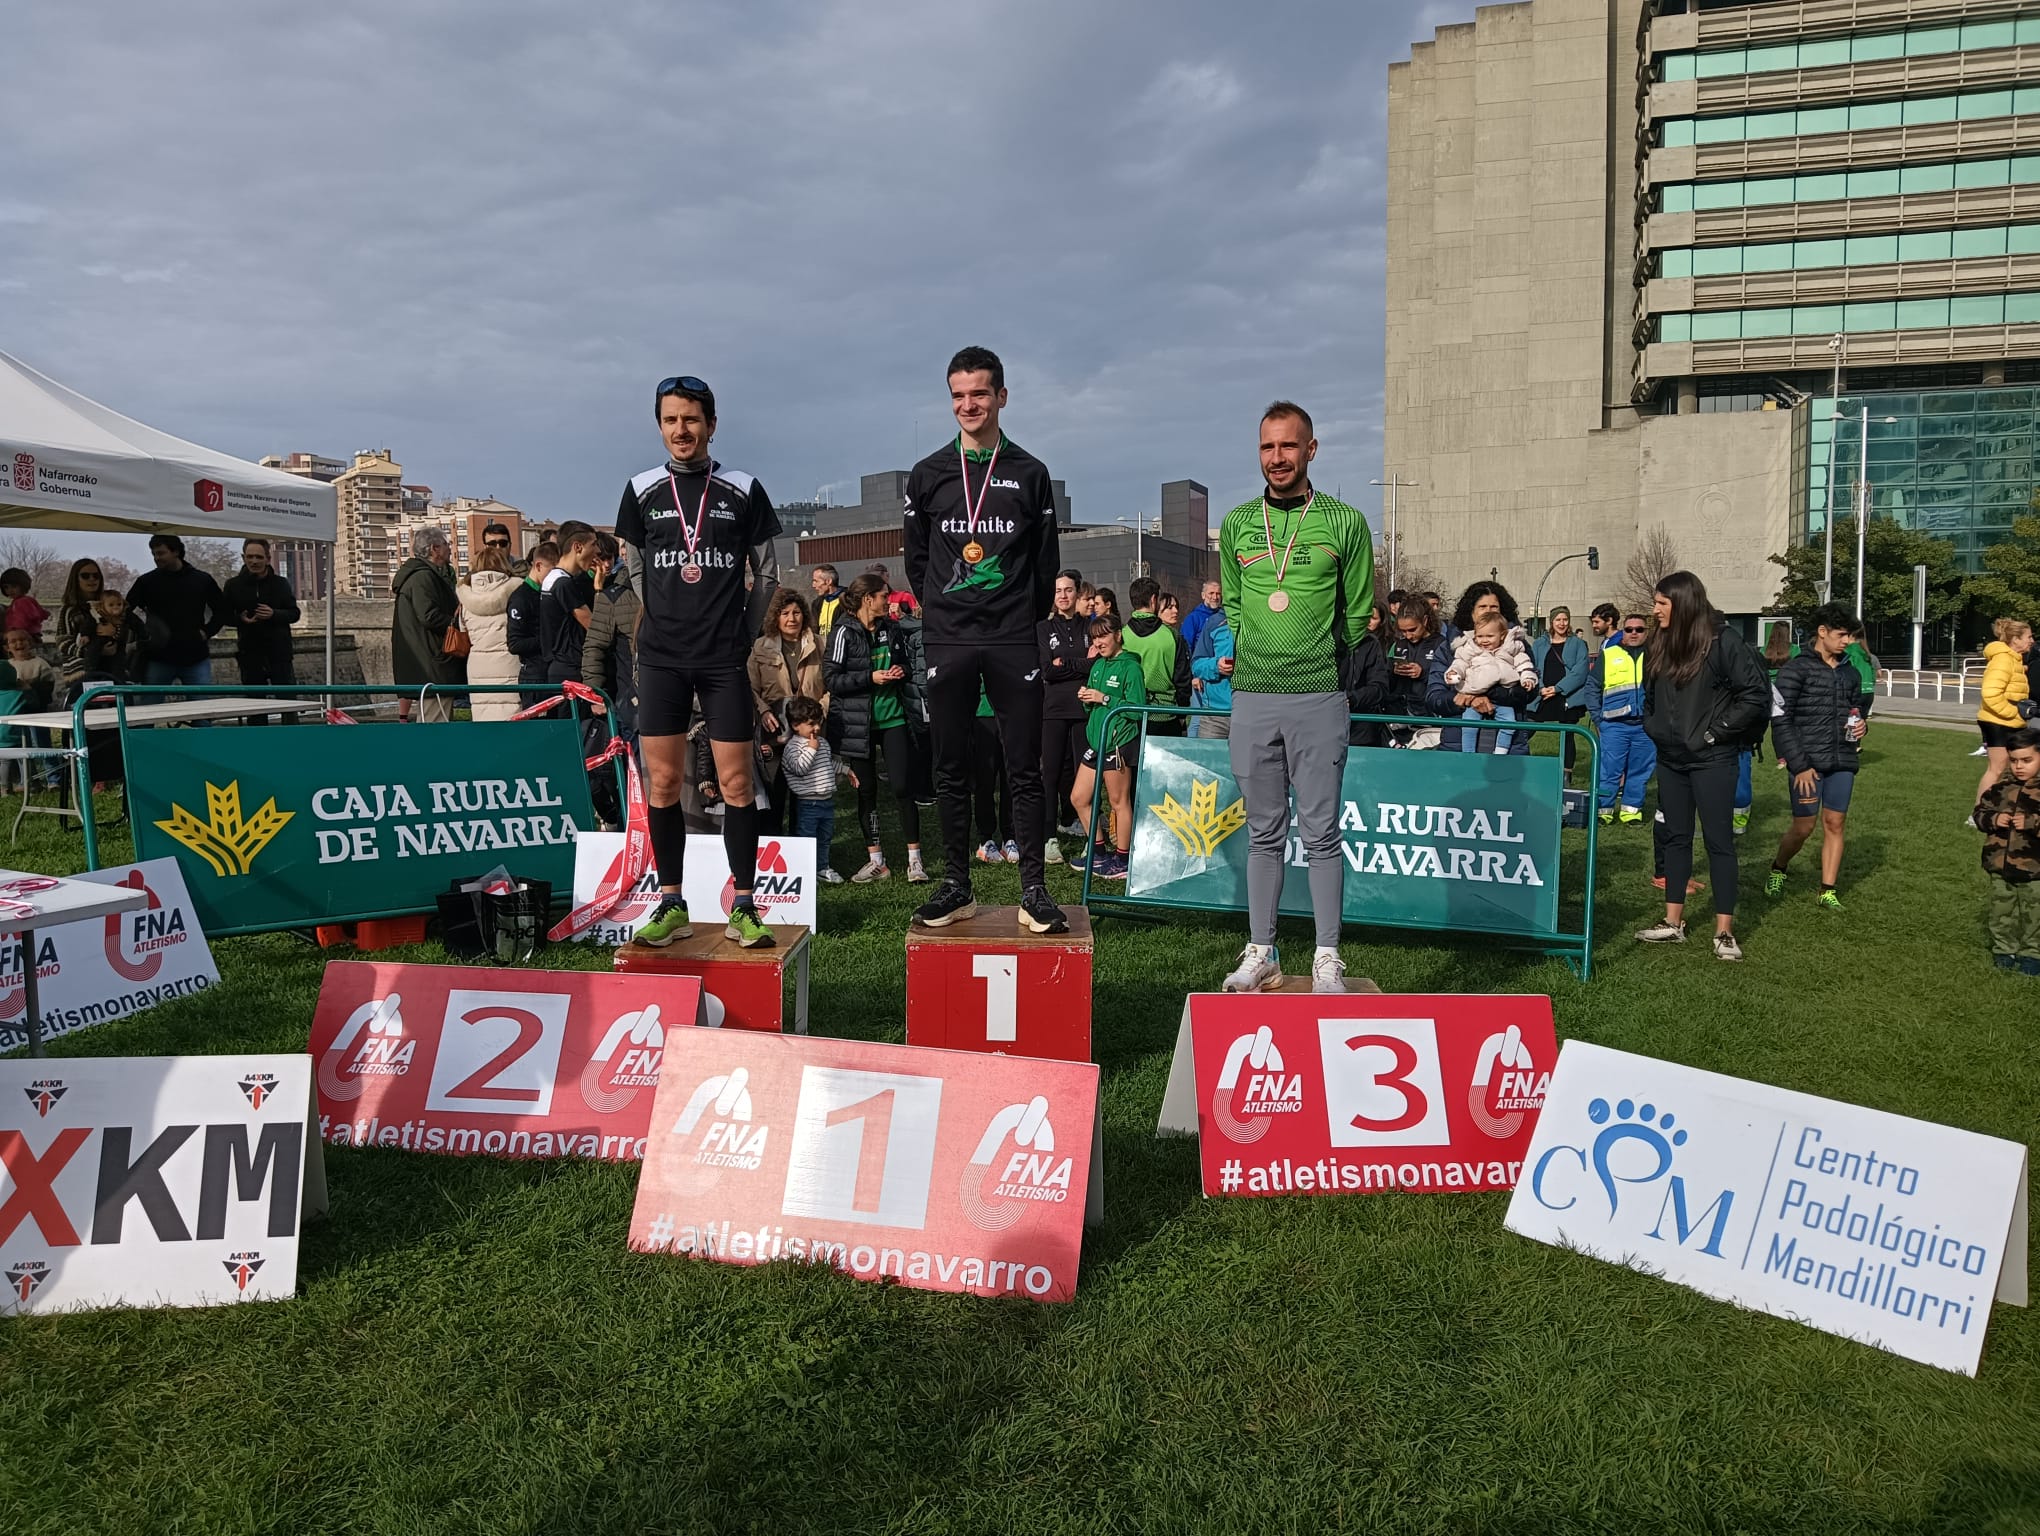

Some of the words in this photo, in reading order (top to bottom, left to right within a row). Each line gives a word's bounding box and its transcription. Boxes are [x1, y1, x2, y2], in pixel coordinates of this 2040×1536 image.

[39, 467, 98, 485] Nafarroako
[40, 482, 91, 498] Gobernua
[227, 501, 261, 511] Nafarroako
[254, 494, 277, 503] Navarro
[288, 498, 311, 507] Deporte
[311, 784, 421, 822] CAJA
[428, 776, 563, 815] RURAL
[315, 825, 380, 864] DE
[396, 813, 578, 859] NAVARRA
[1376, 801, 1525, 843] RURAL
[1341, 840, 1544, 887] NAVARRA
[752, 875, 803, 895] FNA
[752, 895, 801, 904] TLETISMO
[134, 907, 186, 943] FNA
[133, 932, 188, 955] ATLETISMO
[972, 954, 1018, 1041] 1
[346, 1062, 409, 1076] ATLETISMO
[354, 1037, 417, 1066] FNA
[445, 1005, 544, 1102] 2
[1245, 1073, 1303, 1102] FNA
[1345, 1034, 1429, 1133] 3
[1498, 1071, 1551, 1098] FNA
[1241, 1100, 1303, 1114] ATLETISMO
[700, 1122, 769, 1157] FNA
[825, 1088, 895, 1214] 1
[691, 1150, 762, 1170] ATLETISMO
[1000, 1151, 1073, 1188] FNA
[1793, 1126, 1920, 1197] Centro
[992, 1183, 1068, 1204] ATLETISMO
[1778, 1178, 1987, 1277] Podológico
[647, 1213, 1053, 1296] #atletismonavarro
[1763, 1232, 1976, 1336] Mendillorri
